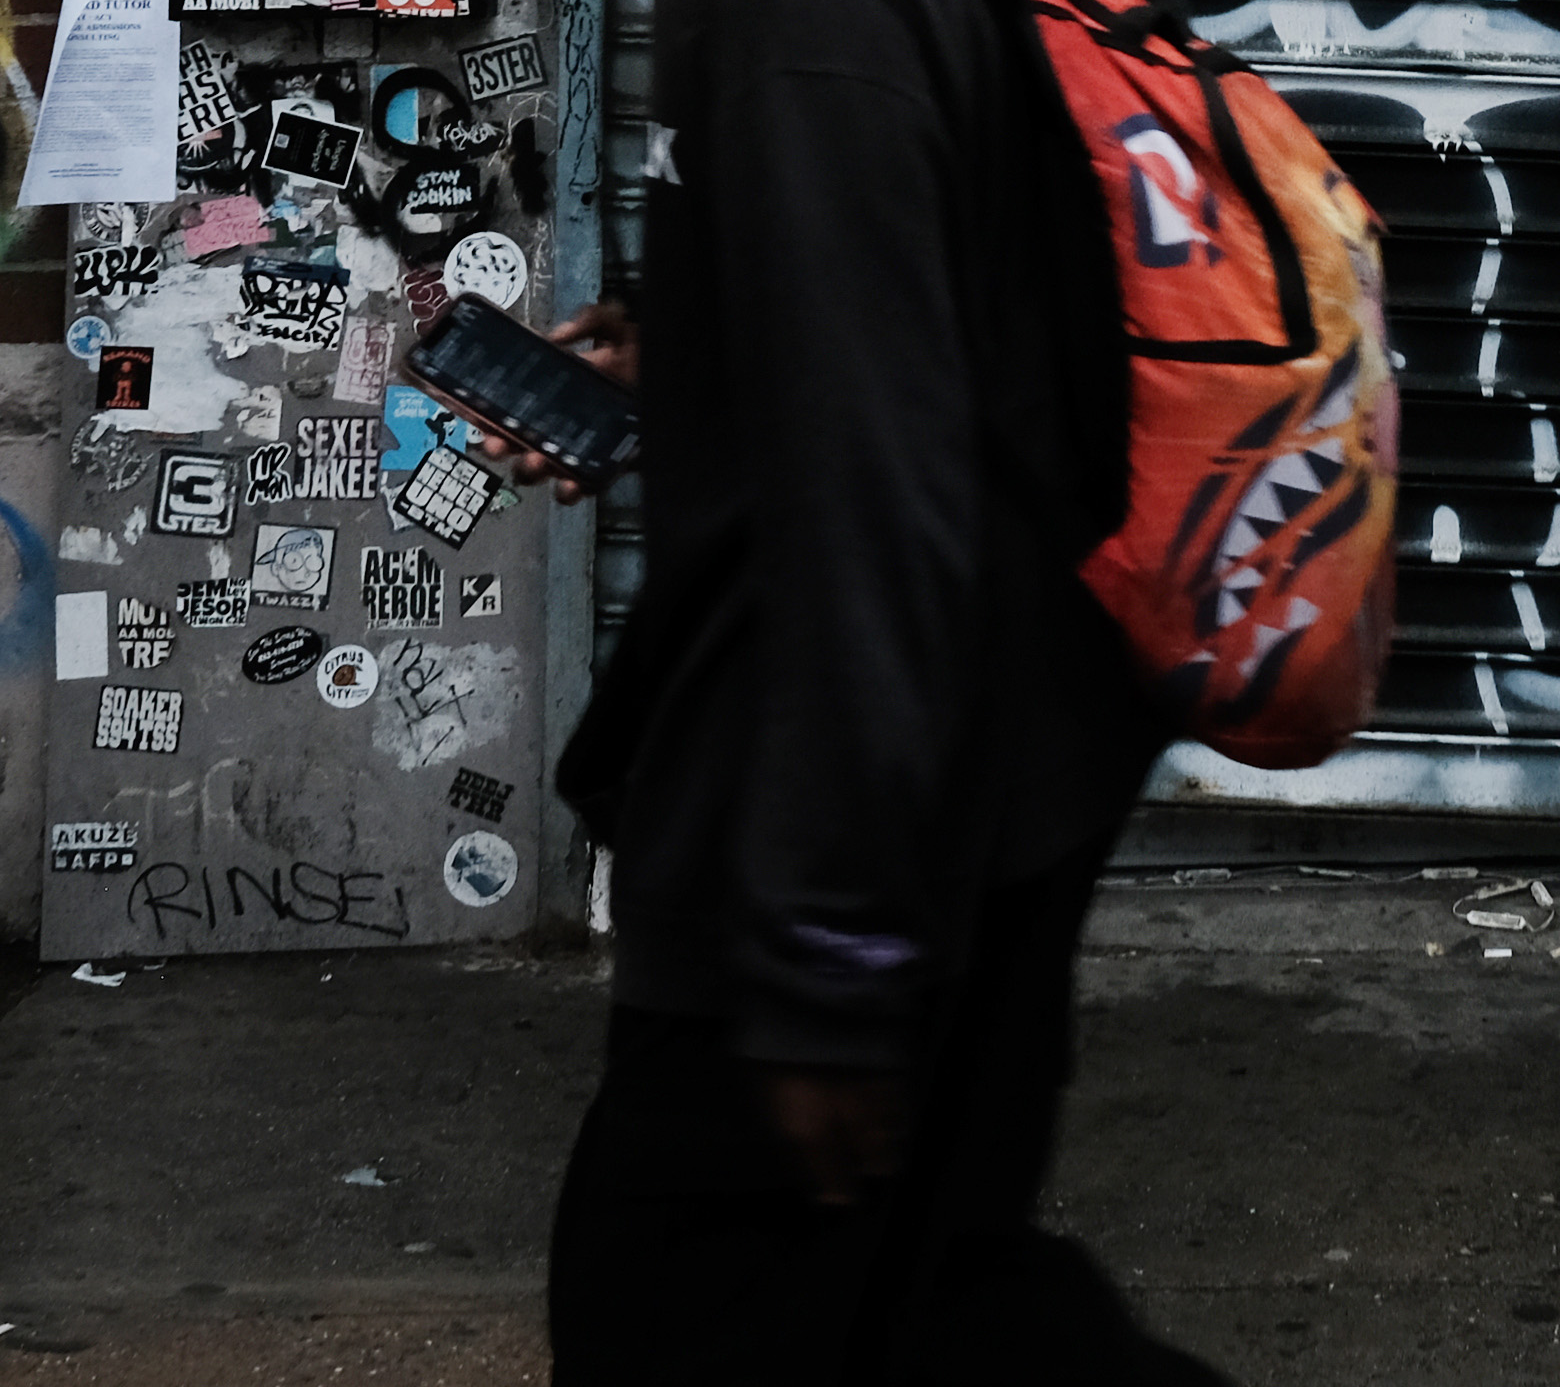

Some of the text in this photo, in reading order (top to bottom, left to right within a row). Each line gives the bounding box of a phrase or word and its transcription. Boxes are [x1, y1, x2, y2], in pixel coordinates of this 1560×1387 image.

[104, 0, 152, 10] TUTOR
[466, 42, 541, 96] 3STER
[296, 416, 379, 458] SEXEL
[294, 457, 378, 500] JAKEE
[324, 649, 364, 676] CITRUS
[100, 685, 183, 722] SOAKER
[325, 682, 352, 700] CITY
[56, 828, 138, 848] AKUZE
